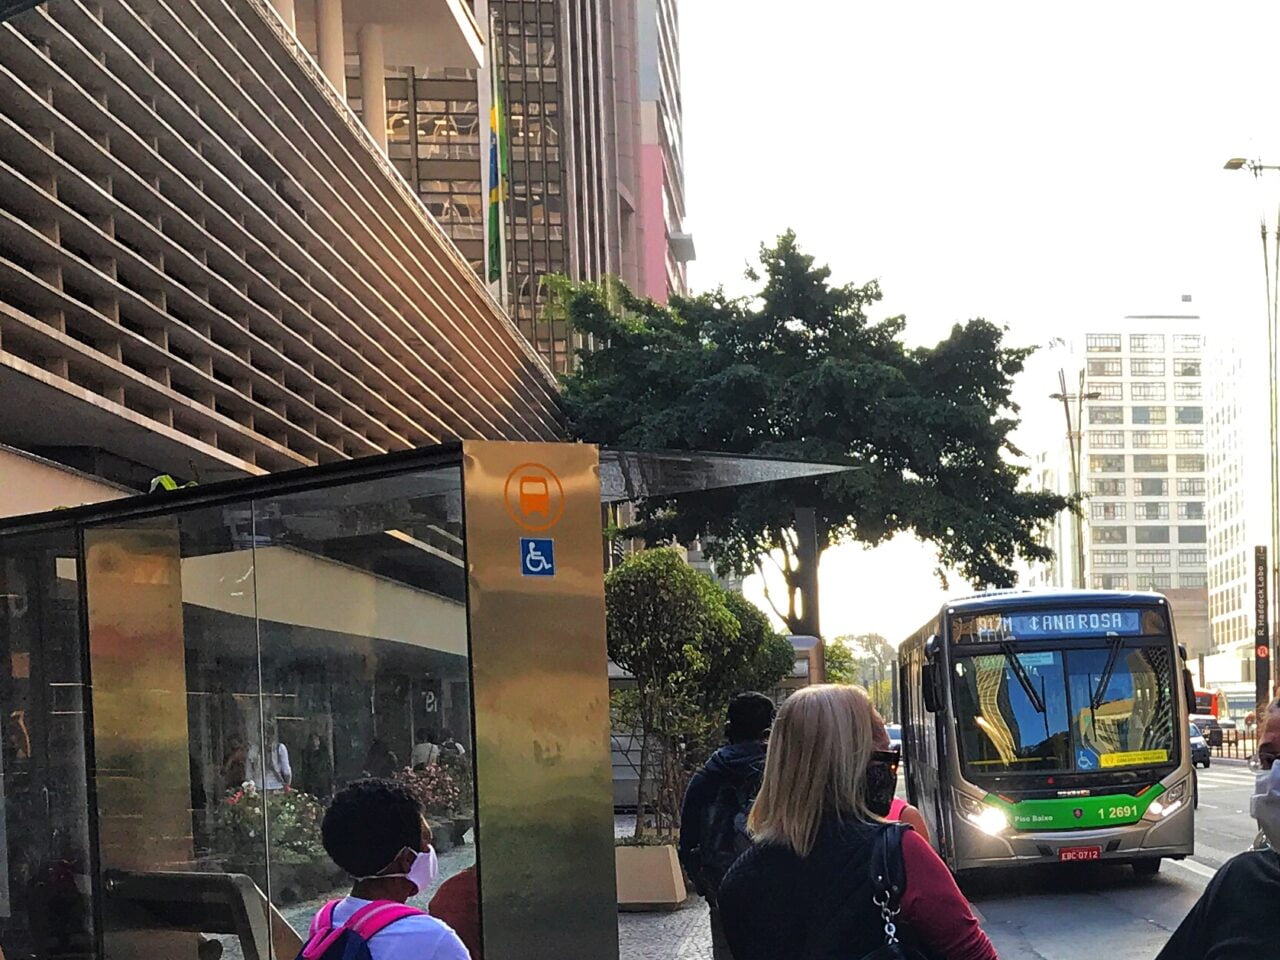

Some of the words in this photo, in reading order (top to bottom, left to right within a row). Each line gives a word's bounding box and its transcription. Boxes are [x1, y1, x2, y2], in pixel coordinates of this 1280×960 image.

[1257, 565, 1265, 588] Lobo
[1257, 589, 1265, 626] Haddock
[1042, 614, 1075, 631] ANA
[1078, 612, 1122, 630] ROSA
[1098, 808, 1105, 819] 1
[1109, 805, 1138, 818] 2691
